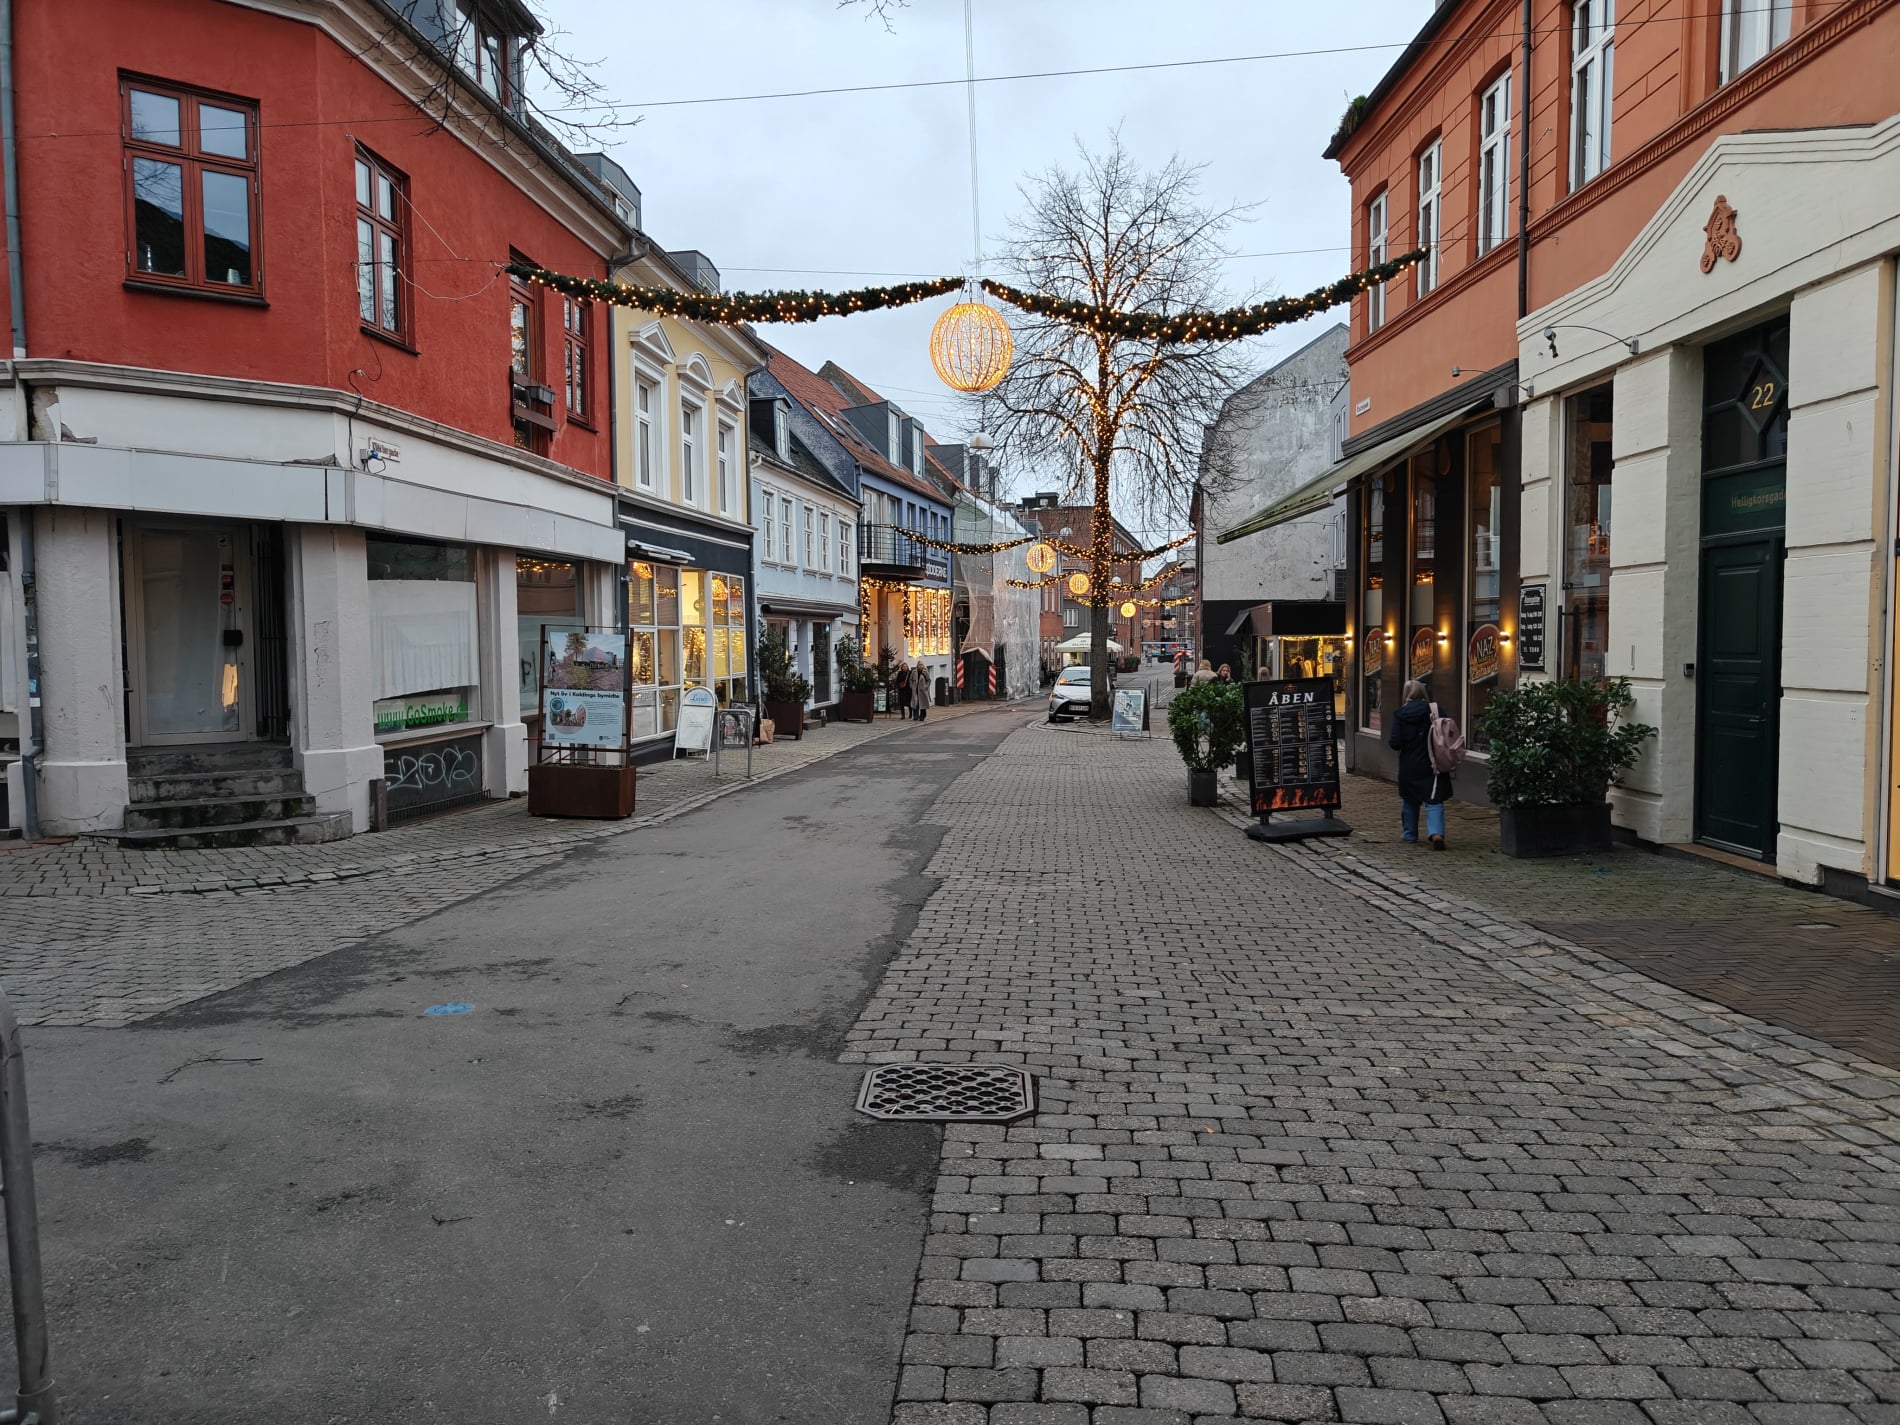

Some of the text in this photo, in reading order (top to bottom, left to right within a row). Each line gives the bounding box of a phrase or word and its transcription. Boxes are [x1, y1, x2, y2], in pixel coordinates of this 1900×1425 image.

[1751, 382, 1774, 410] 22
[1416, 638, 1433, 658] NAZ
[1476, 635, 1494, 657] NAZ
[1268, 691, 1314, 705] ÅBEN
